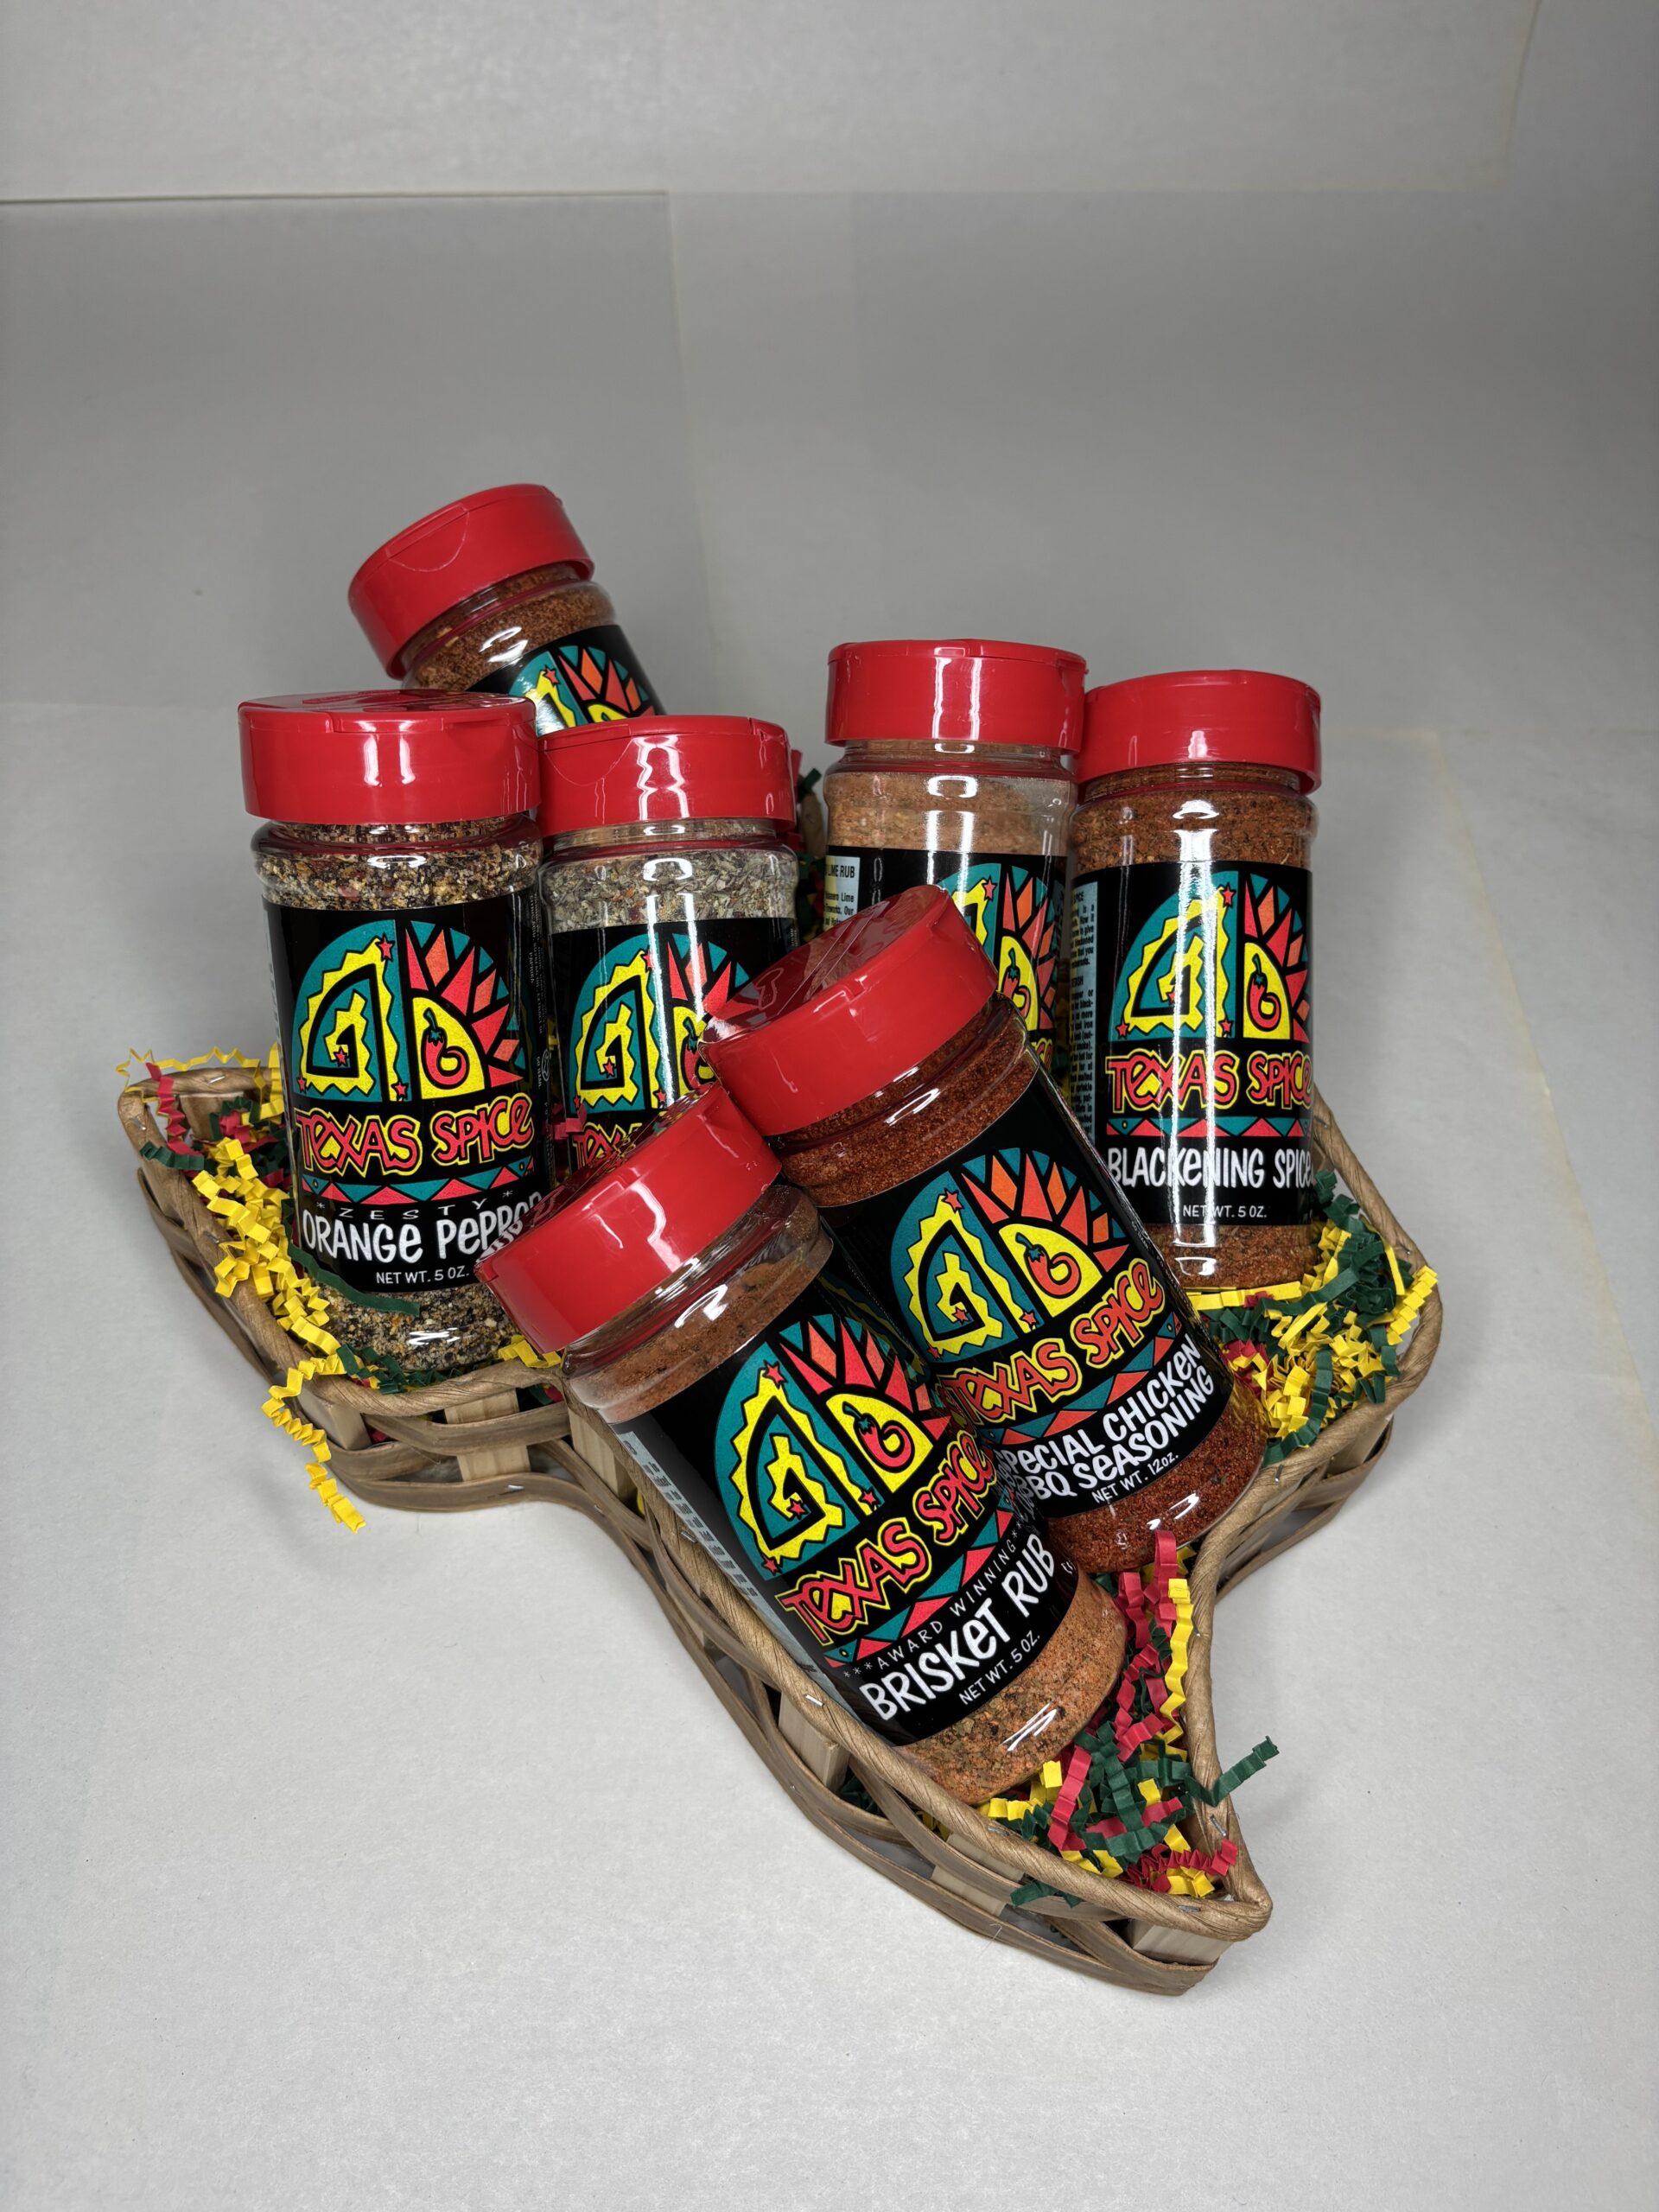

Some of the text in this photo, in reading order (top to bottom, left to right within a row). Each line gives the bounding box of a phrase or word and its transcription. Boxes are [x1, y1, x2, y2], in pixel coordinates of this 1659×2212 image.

[840, 866, 855, 878] RUB
[295, 1107, 422, 1177] TeXAS
[431, 1092, 534, 1166] SPICe
[338, 1198, 487, 1220] ZESTY
[1183, 1205, 1268, 1218] NET WT. 5 OZ.
[302, 1210, 423, 1263] ORANGe
[376, 1265, 469, 1284] NET WT. 5 OZ.
[1091, 1484, 1118, 1504] NET
[1120, 1471, 1148, 1491] WT.
[775, 1517, 931, 1646] TeXAS
[877, 1539, 1017, 1670] AWARD WINNING
[859, 1533, 1056, 1721] BRISKeT RUB
[958, 1630, 1041, 1706] NET WT. 5 OZ.
